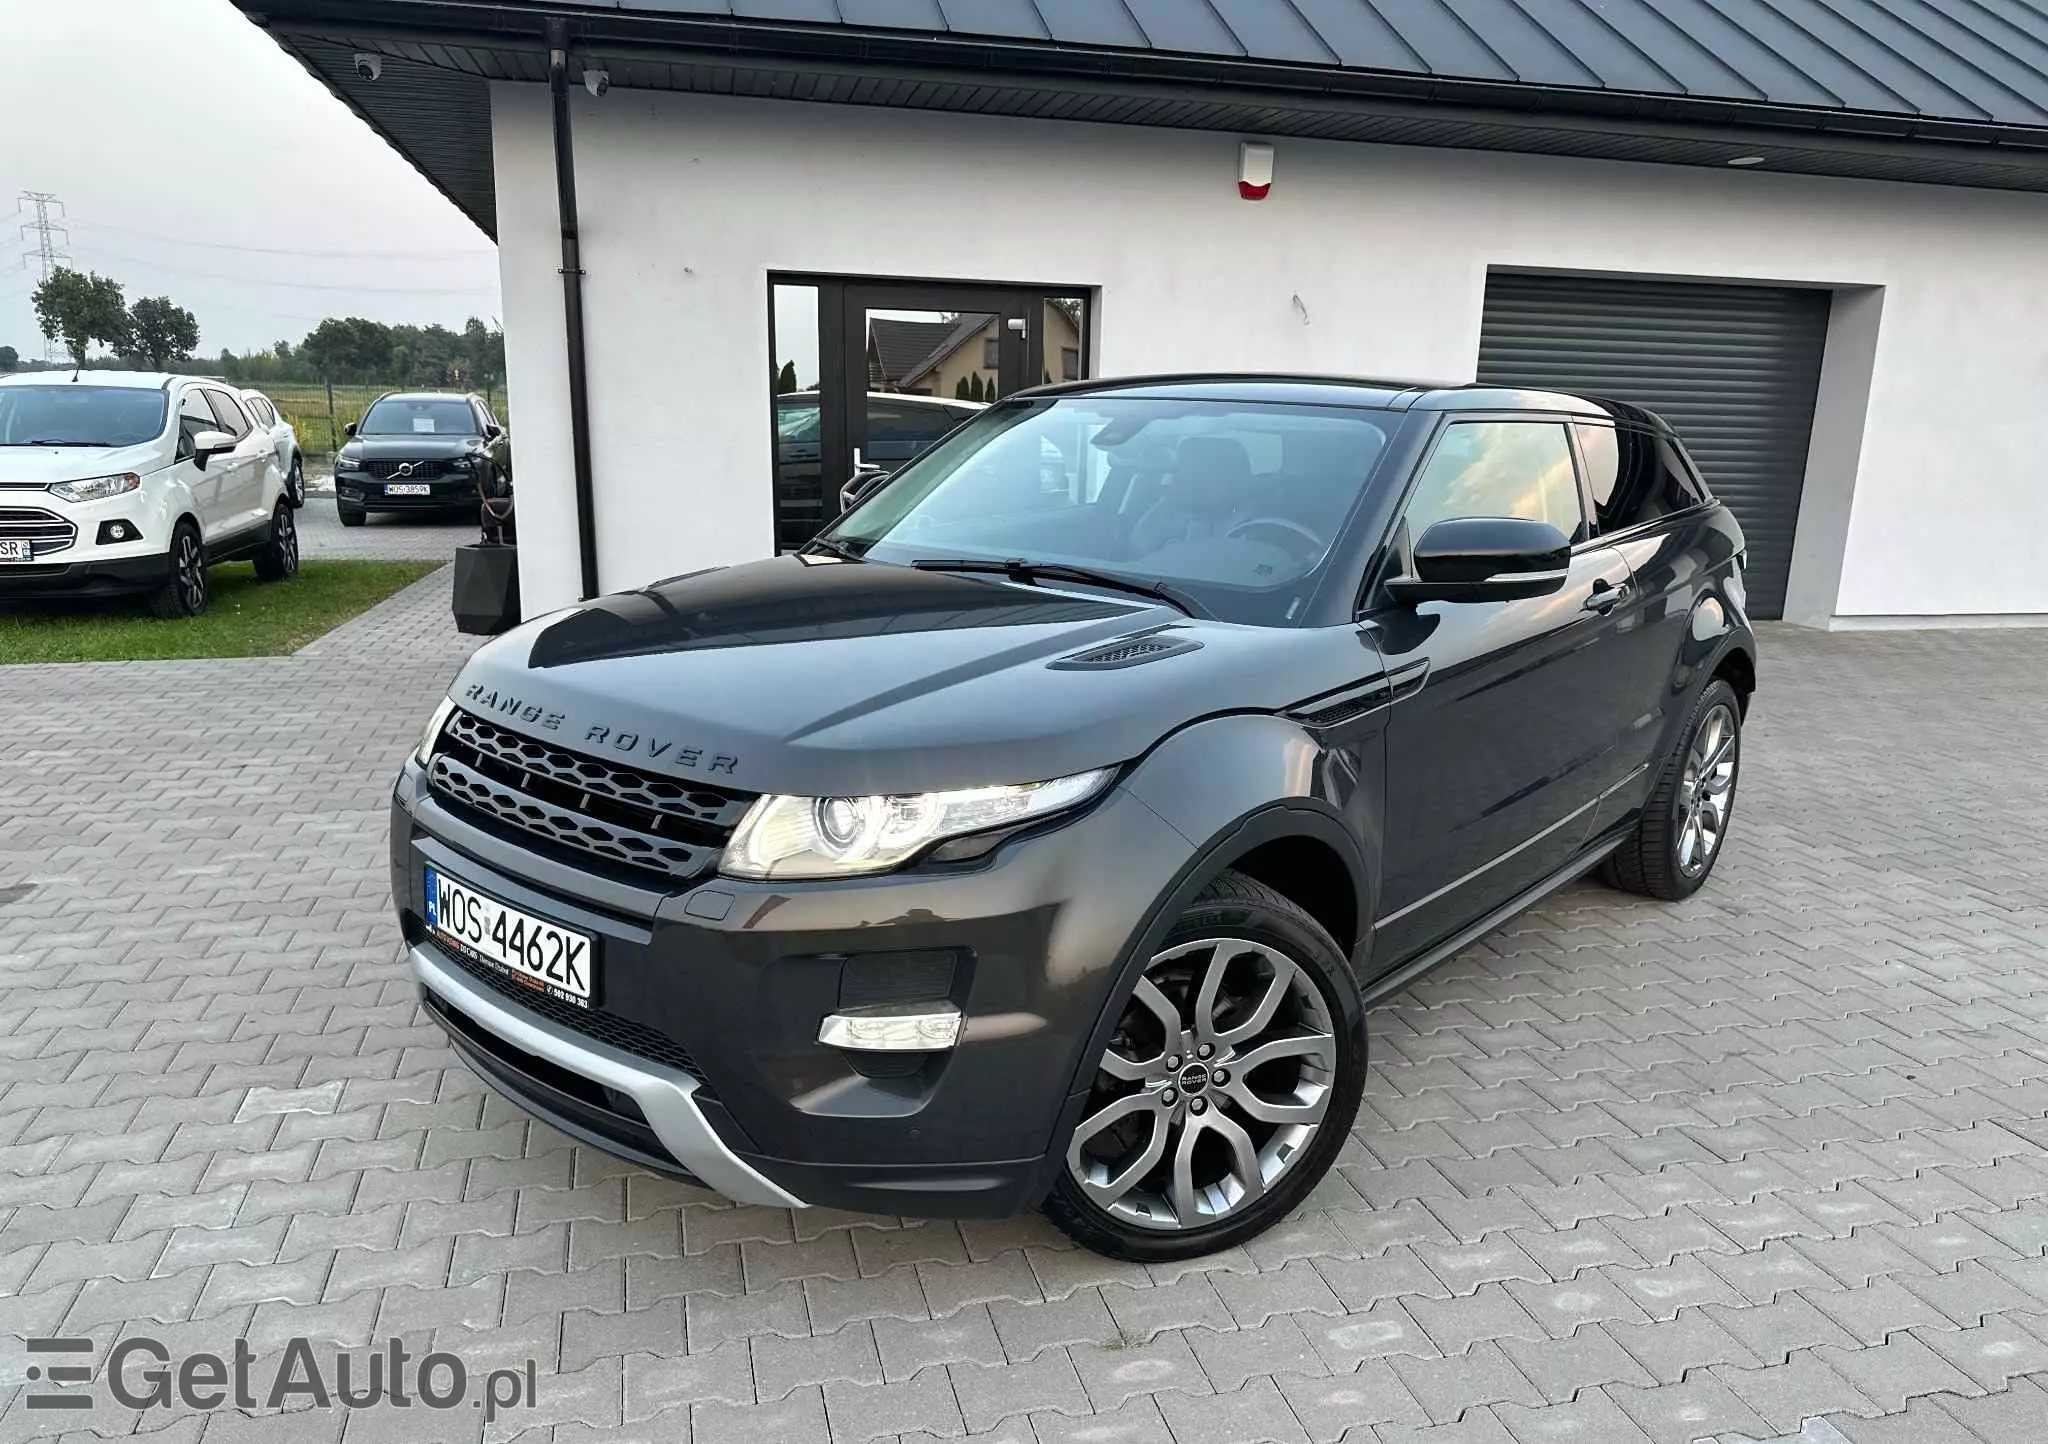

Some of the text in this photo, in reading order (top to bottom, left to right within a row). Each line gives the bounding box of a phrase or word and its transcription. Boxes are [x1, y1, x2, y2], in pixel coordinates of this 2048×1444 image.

[466, 684, 739, 775] RANGE ROVER
[438, 878, 586, 991] WOS 4462K
[1182, 1073, 1207, 1081] RANGE
[1182, 1077, 1207, 1085] ROVER
